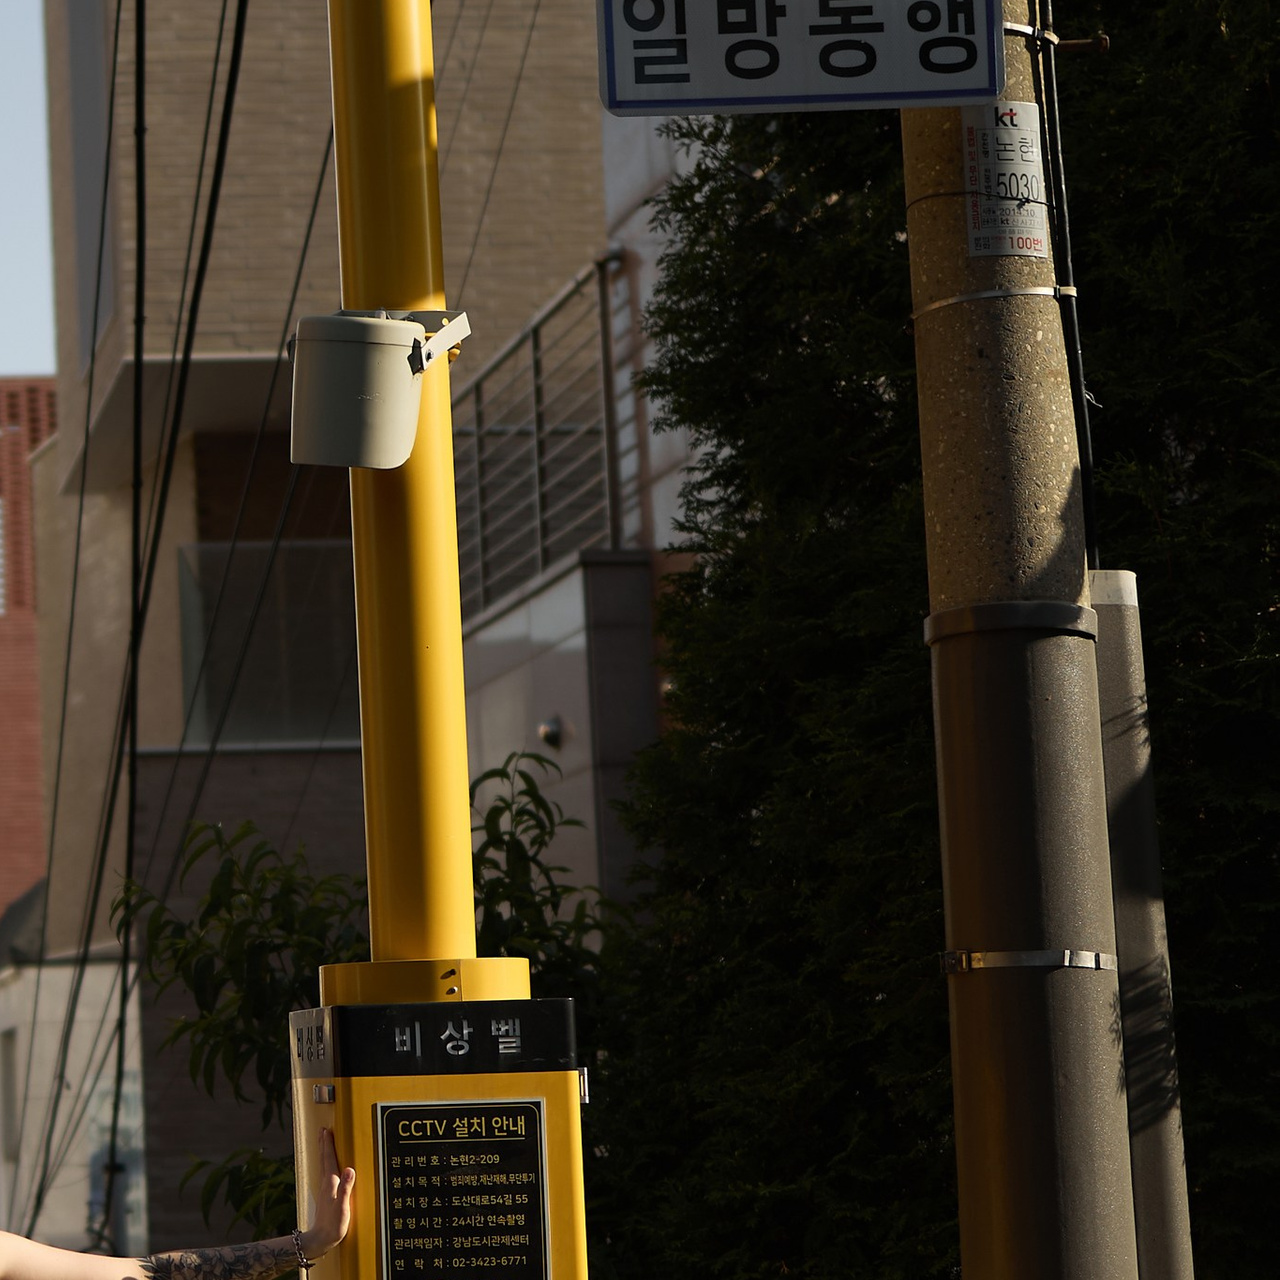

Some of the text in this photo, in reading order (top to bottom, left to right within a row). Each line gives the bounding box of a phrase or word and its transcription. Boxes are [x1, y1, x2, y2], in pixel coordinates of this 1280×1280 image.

[994, 106, 1018, 127] kt
[996, 136, 1035, 163] 논현
[996, 173, 1040, 201] 5030
[1009, 236, 1043, 252] 100번
[398, 1115, 526, 1137] CCTV 설치 안내
[450, 1154, 500, 1166] 논현2-209
[451, 1193, 513, 1207] 도산대로54길
[515, 1194, 529, 1204] 55
[452, 1215, 484, 1227] 24시간
[452, 1256, 527, 1267] 02-3423-6771
